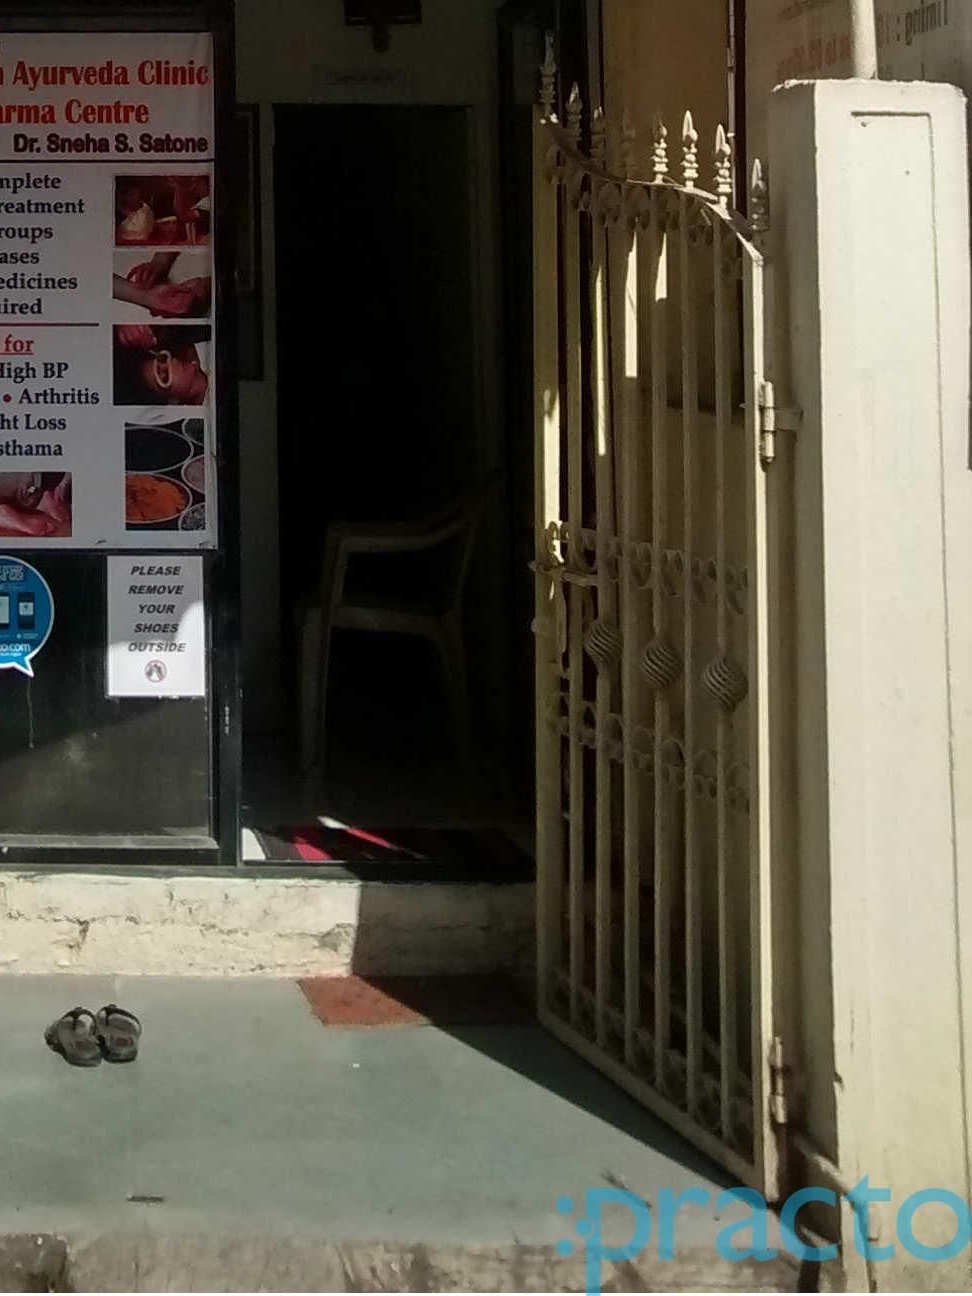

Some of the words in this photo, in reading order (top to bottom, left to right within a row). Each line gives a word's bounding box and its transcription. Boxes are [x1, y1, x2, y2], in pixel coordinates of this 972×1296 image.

[12, 60, 129, 90] Ayurveda
[138, 60, 208, 86] Clinic
[64, 99, 149, 124] Centre
[13, 134, 41, 154] Dr.
[47, 134, 110, 154] Sneha
[115, 134, 135, 154] S.
[139, 134, 208, 154] Satone
[42, 363, 69, 379] BP
[19, 388, 100, 405] Arthritis
[25, 414, 67, 431] Loss
[130, 565, 182, 576] PLEASE
[127, 584, 185, 596] REMOVE
[138, 603, 176, 615] YOUR
[133, 622, 180, 634] SHOES
[127, 641, 187, 653] OUTSIDE
